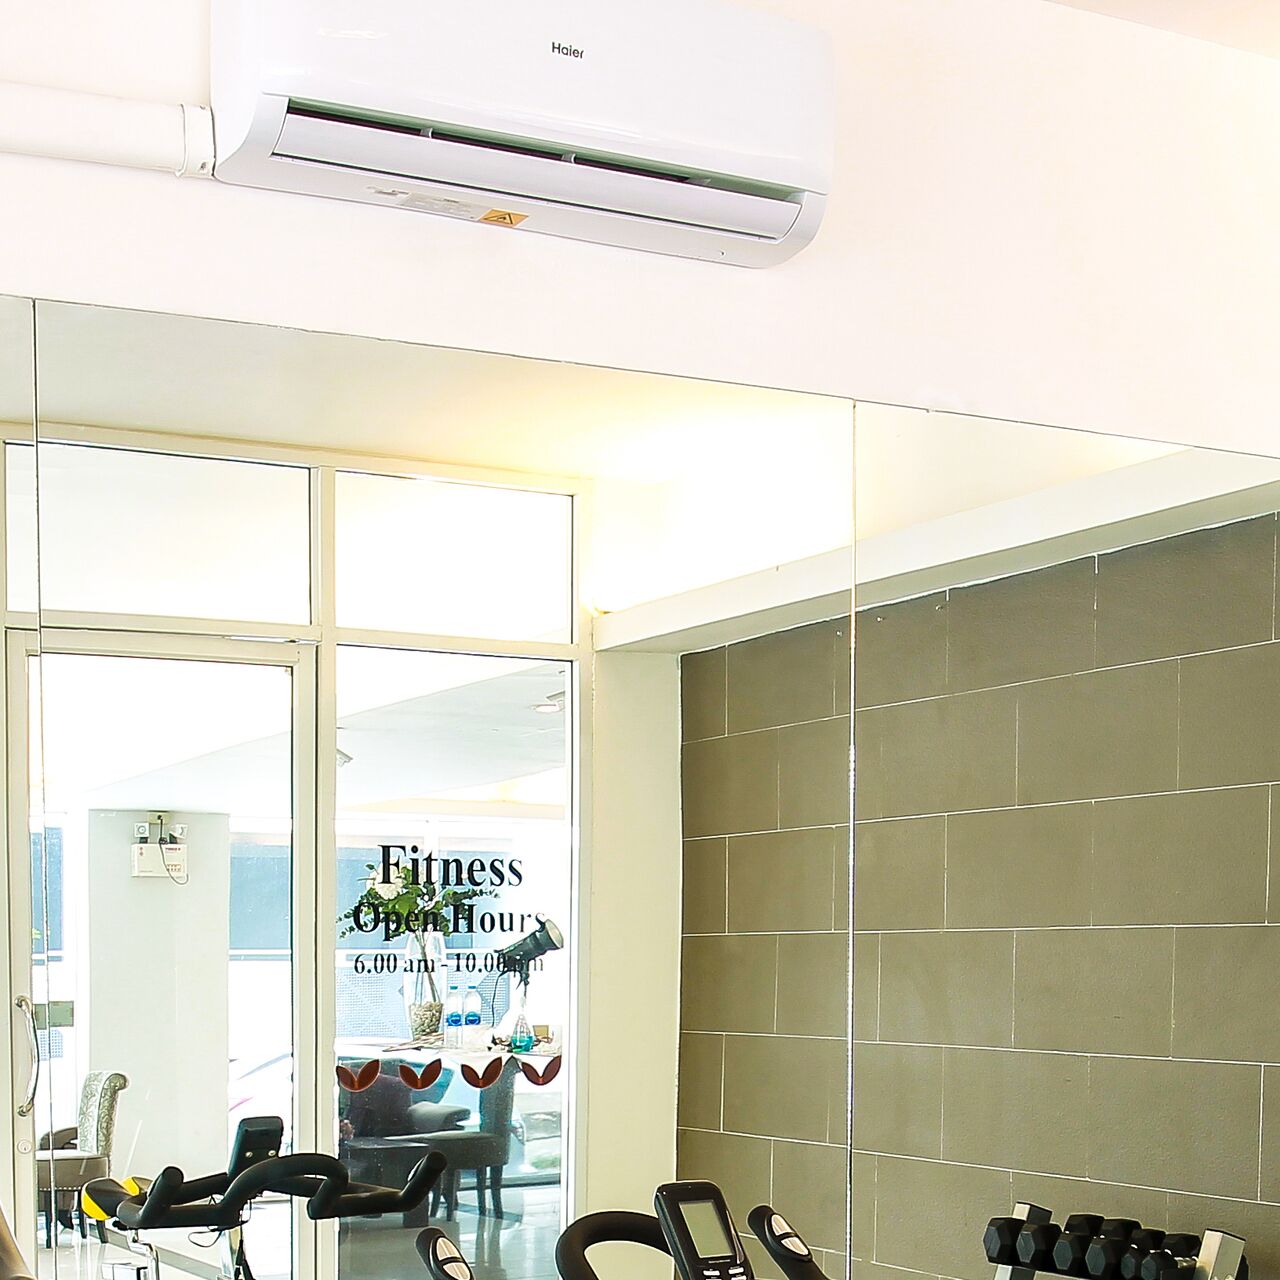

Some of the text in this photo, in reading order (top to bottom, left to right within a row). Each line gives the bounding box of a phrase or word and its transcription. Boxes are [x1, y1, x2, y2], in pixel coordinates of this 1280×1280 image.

[551, 41, 585, 59] Haier
[377, 844, 523, 887] Fitness
[353, 902, 545, 942] Open Hours
[354, 953, 398, 974] 6.00
[403, 958, 436, 973] am
